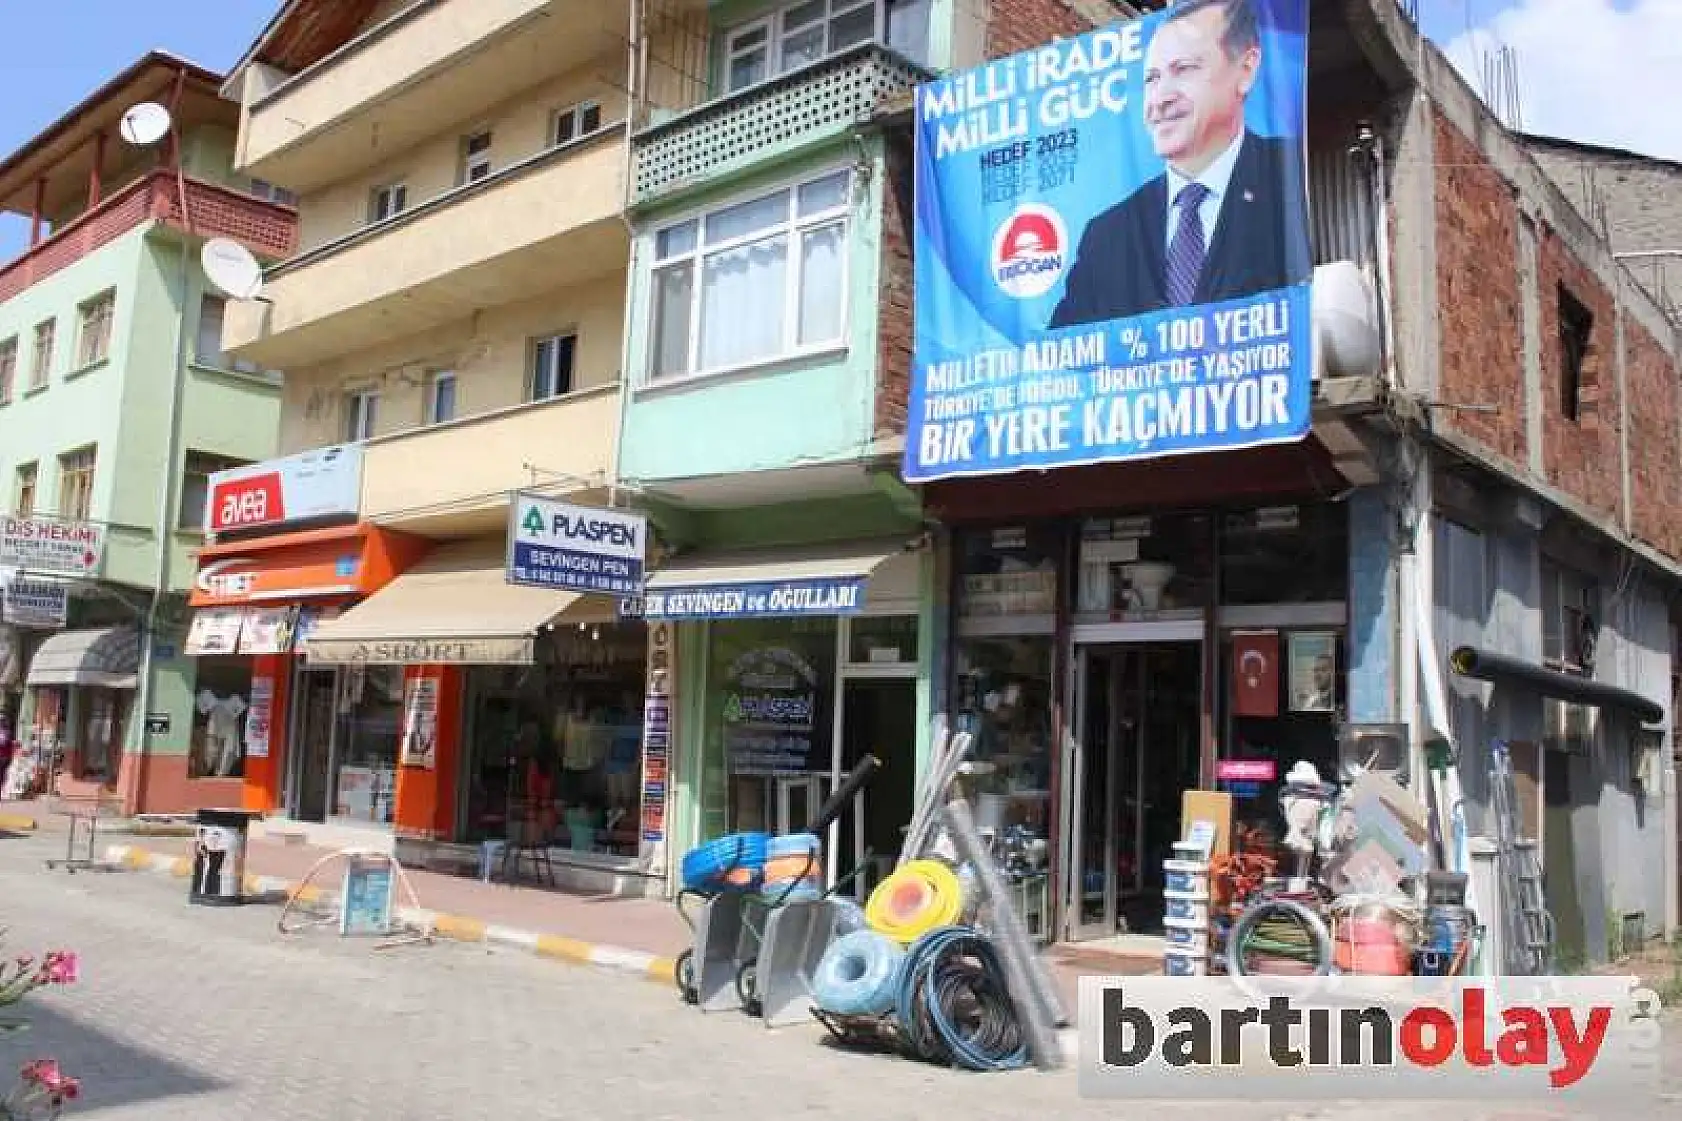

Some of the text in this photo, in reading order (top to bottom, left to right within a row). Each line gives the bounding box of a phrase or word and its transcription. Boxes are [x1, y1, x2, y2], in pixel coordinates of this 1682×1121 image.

[924, 22, 1143, 120] MİLLİ İRADE
[937, 70, 1127, 158] MİLLİ GÜÇ
[980, 128, 1077, 169] HEDEF 2023
[1023, 332, 1105, 372] ADAMI
[1121, 326, 1147, 360] %
[1157, 317, 1205, 353] 100
[1213, 300, 1289, 343] YERLİ
[1200, 343, 1291, 380] YAŞIYOR
[919, 375, 1290, 467] BİR YERE KAÇMIYOR
[222, 489, 267, 525] avea
[553, 514, 635, 549] PLASPEN
[769, 584, 858, 611] OĞULLARI
